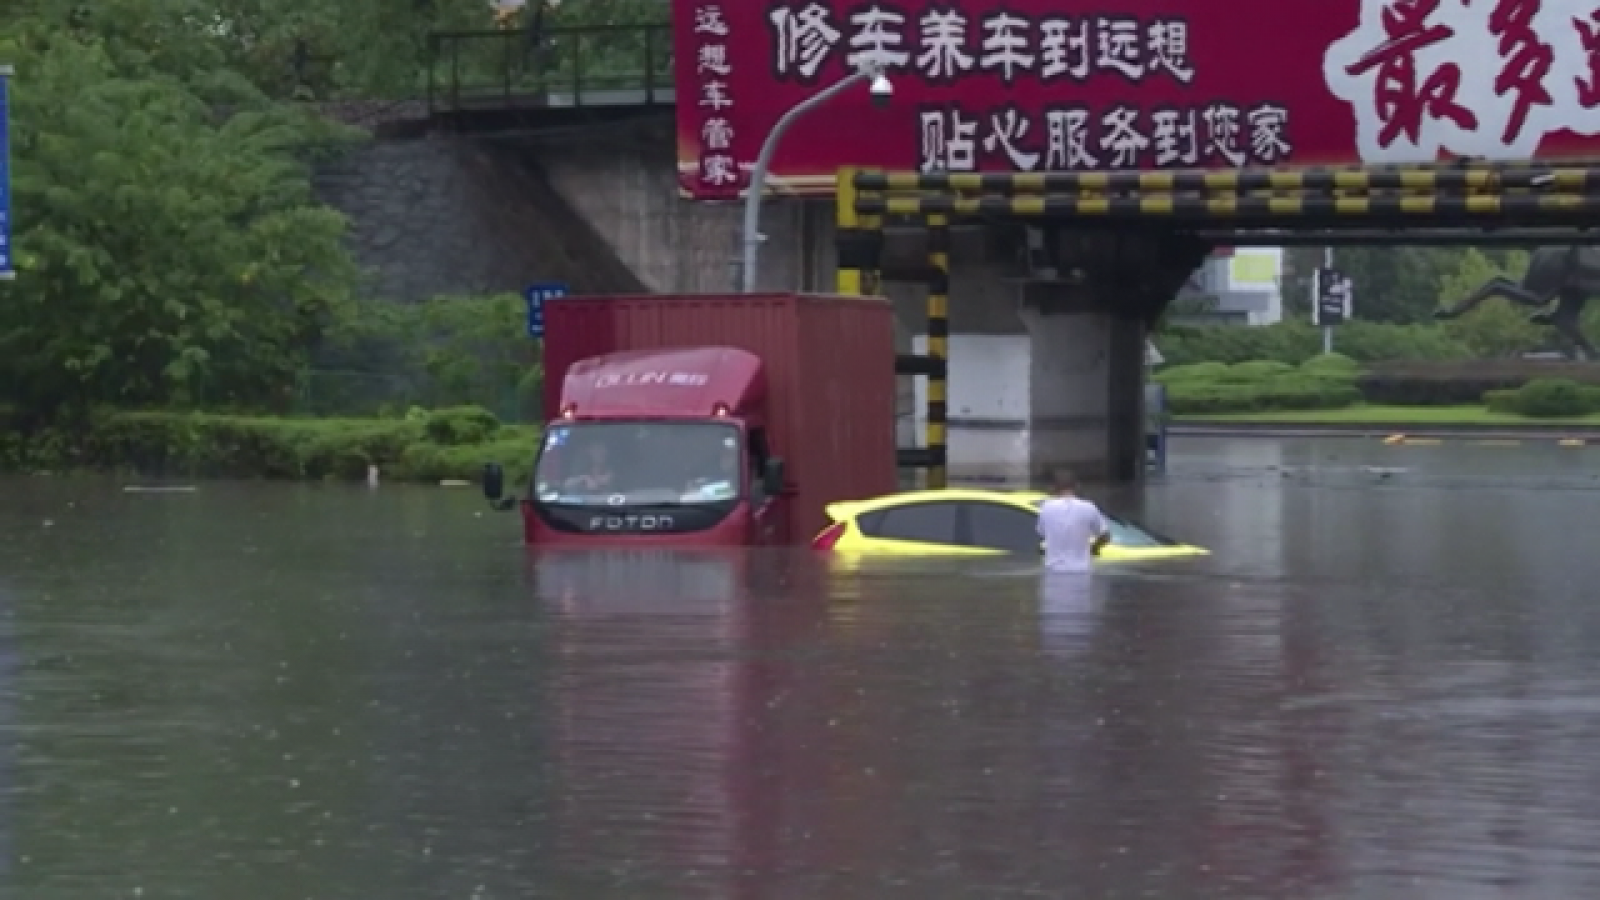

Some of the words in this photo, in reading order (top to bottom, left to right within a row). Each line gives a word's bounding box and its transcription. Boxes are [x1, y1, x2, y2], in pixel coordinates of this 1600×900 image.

[770, 4, 1195, 83] 修车养车到远想
[694, 4, 738, 186] 远想车管家
[919, 104, 1293, 172] 贴心服务到您家
[589, 514, 674, 531] FOTON
